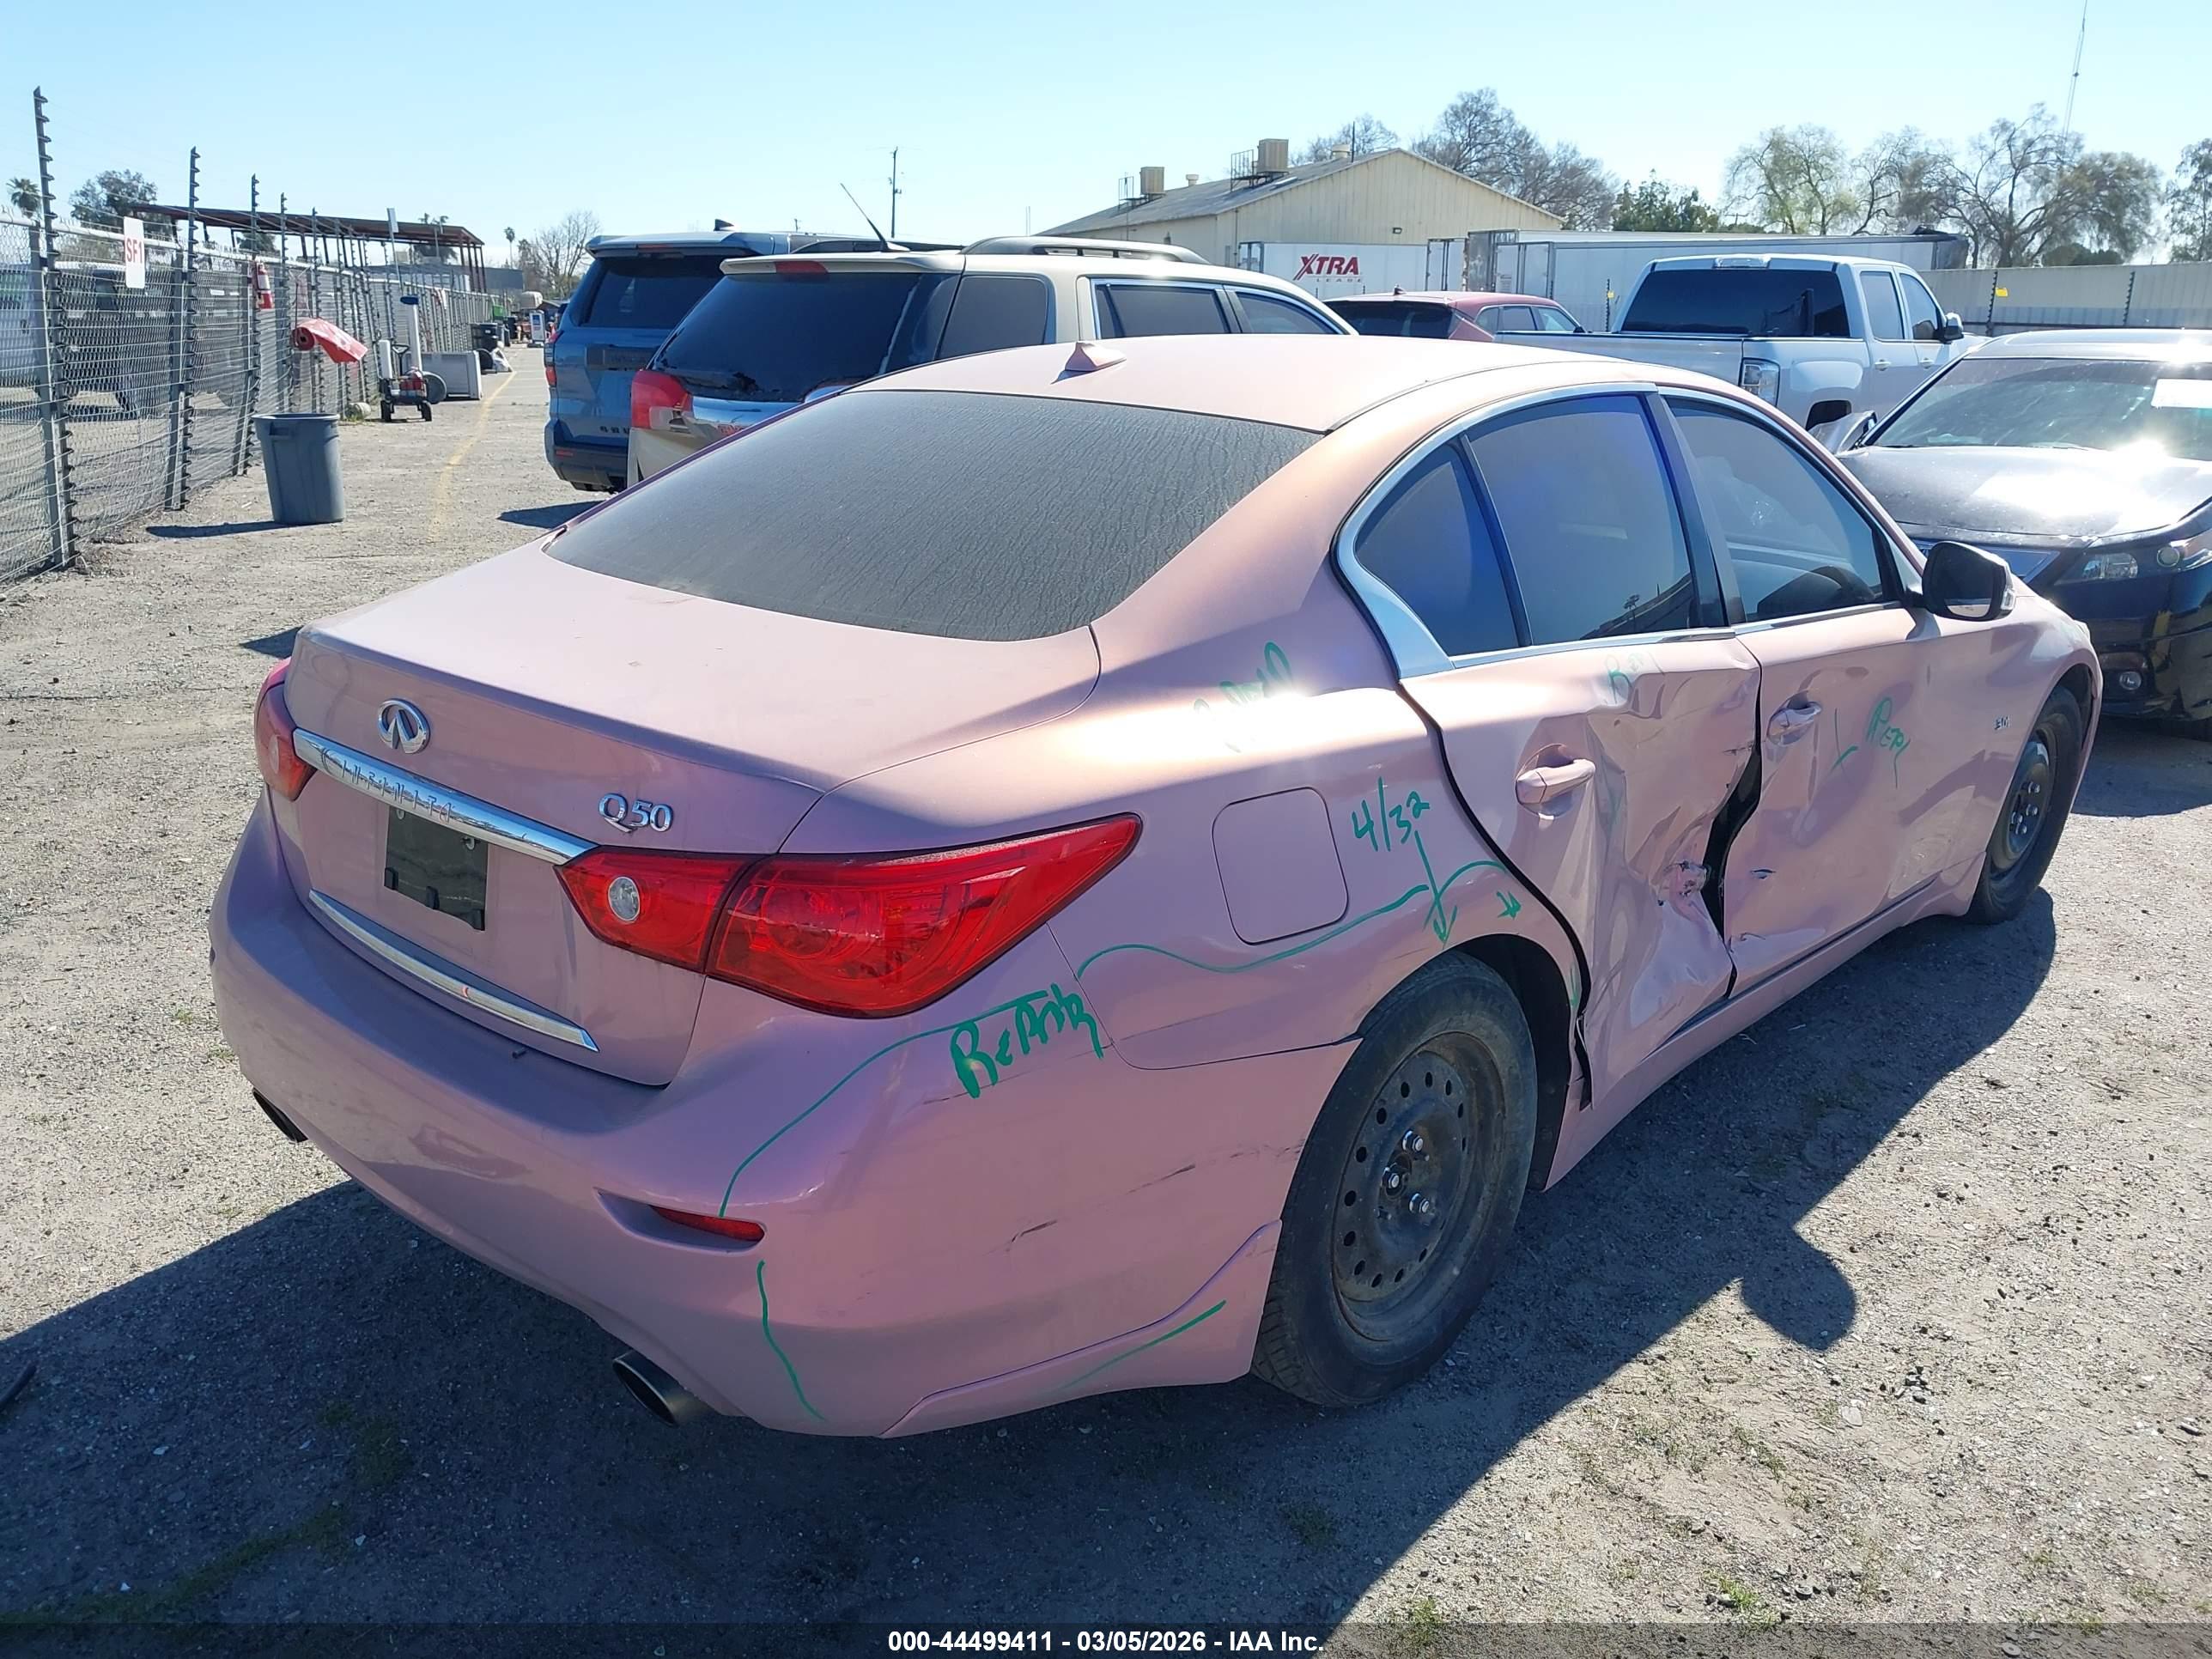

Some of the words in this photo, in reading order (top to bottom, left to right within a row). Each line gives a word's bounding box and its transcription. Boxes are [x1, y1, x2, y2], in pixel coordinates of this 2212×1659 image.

[126, 237, 143, 264] SF1
[1292, 254, 1359, 281] XTRA
[599, 793, 674, 833] Q50
